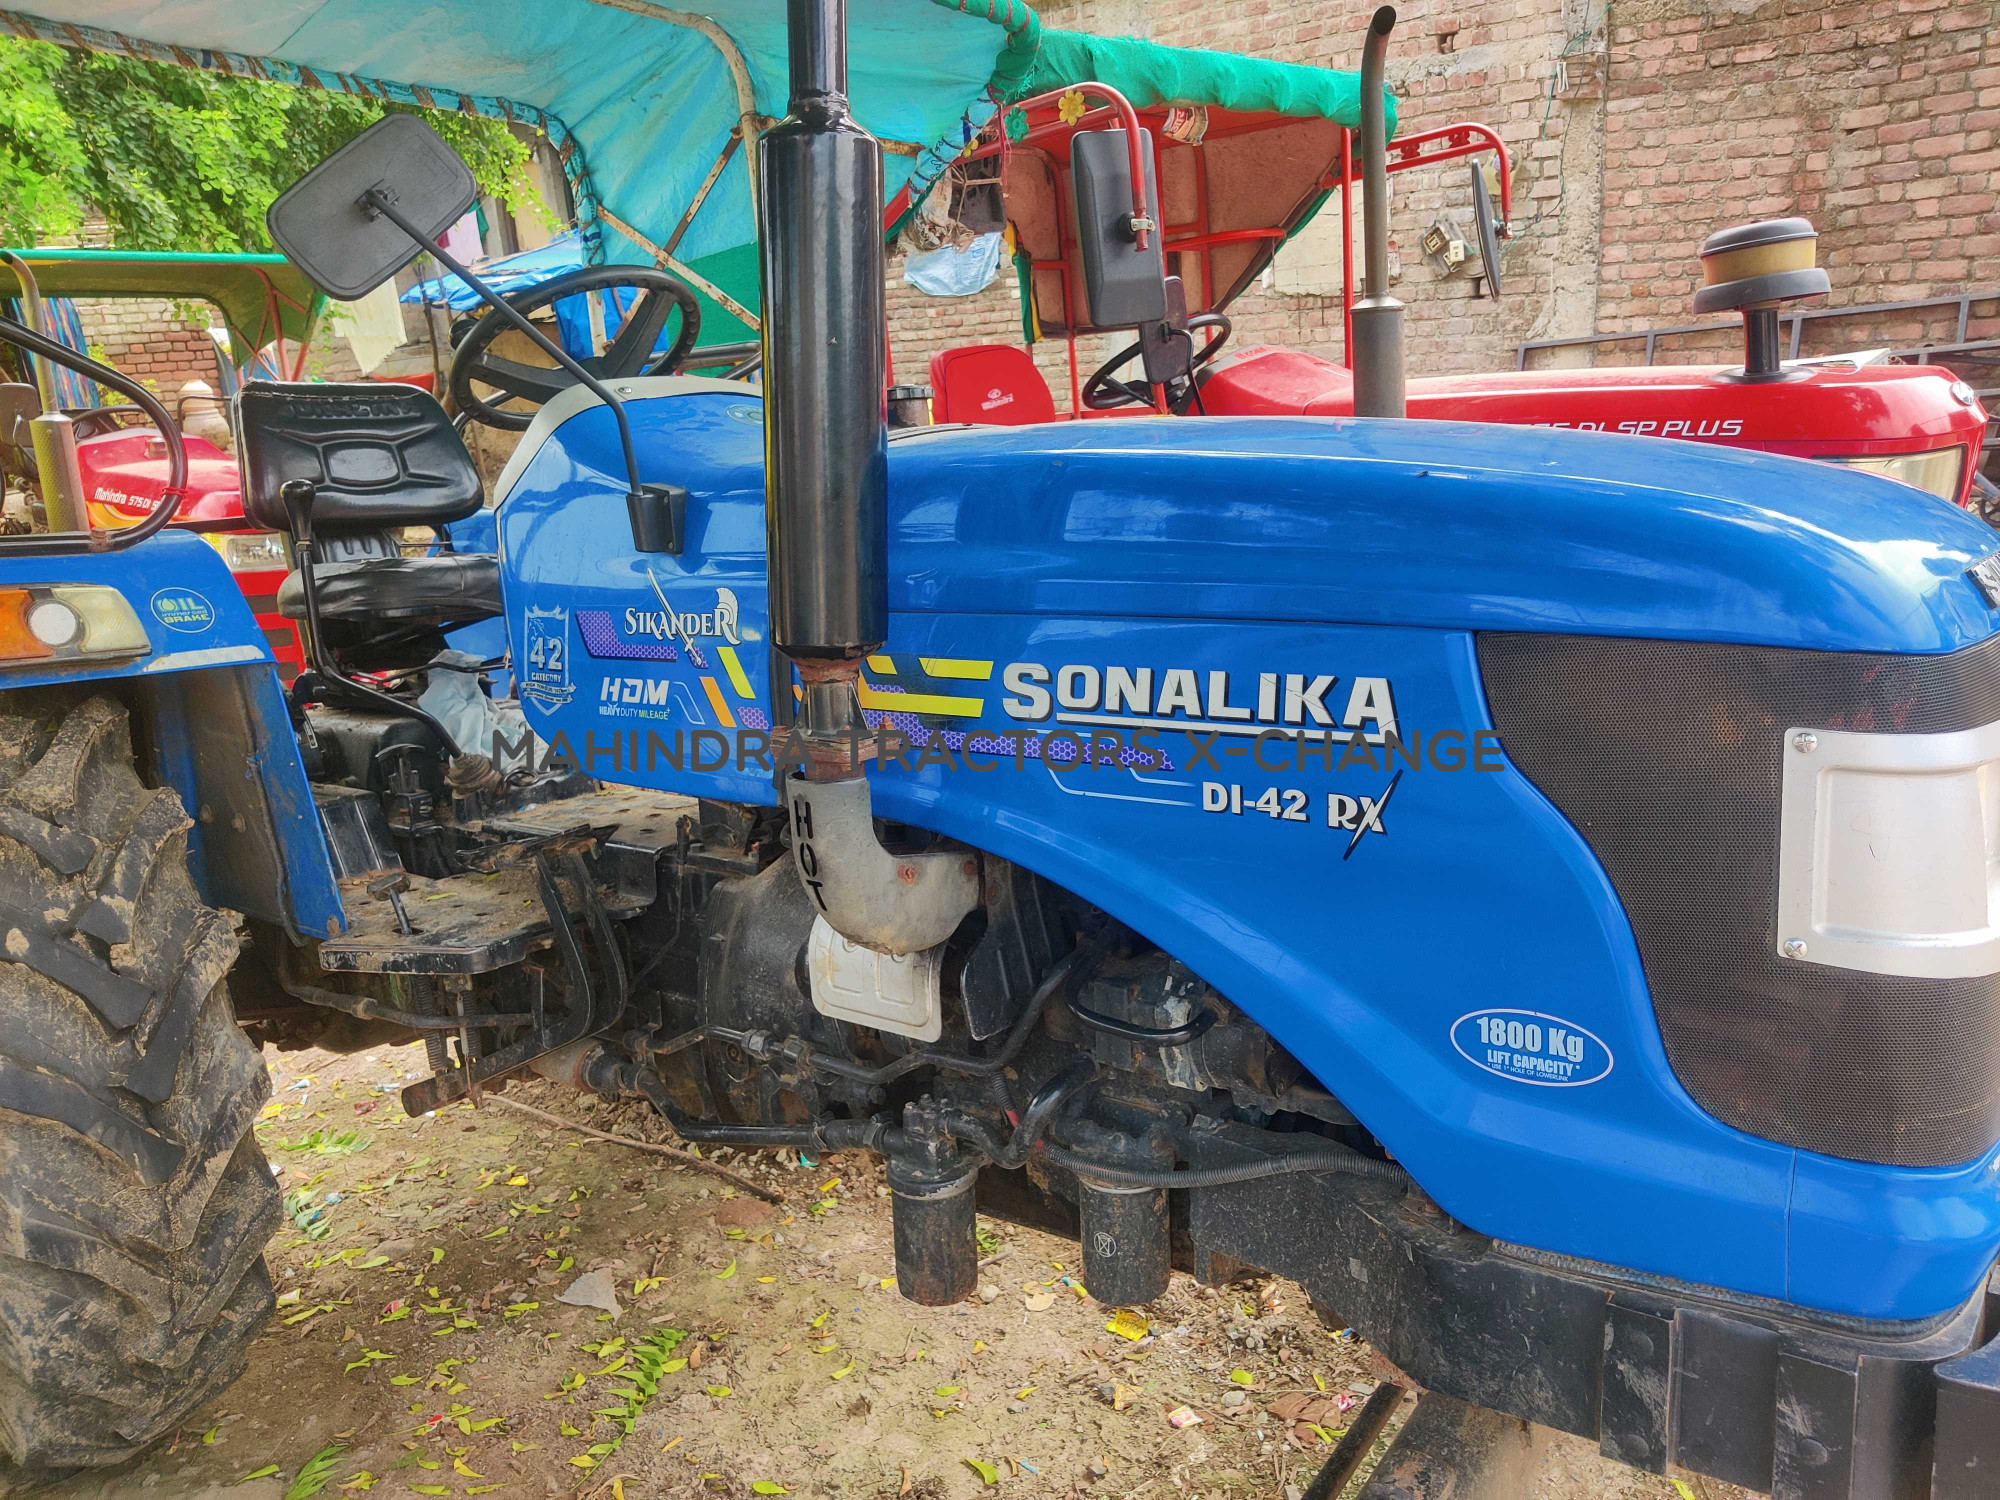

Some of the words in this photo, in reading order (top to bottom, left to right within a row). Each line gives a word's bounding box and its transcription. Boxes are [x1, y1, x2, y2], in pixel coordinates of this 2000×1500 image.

[1618, 421, 1658, 436] SP
[1661, 420, 1744, 437] PLUS
[94, 487, 127, 505] Mahindra
[157, 597, 206, 612] OIL
[164, 613, 211, 624] BRAKE
[530, 637, 563, 671] 42
[531, 672, 562, 683] CATEGORY
[600, 676, 670, 706] HDM
[599, 704, 620, 717] HEAVY
[620, 707, 638, 717] DUTY
[1002, 662, 1399, 745] SONALIKA
[1202, 781, 1309, 823] DI-42
[794, 799, 828, 912] HOT
[1476, 1016, 1542, 1053] 1800
[1548, 1027, 1584, 1063] Kg
[1487, 1049, 1511, 1065] LIFT
[1510, 1066, 1526, 1075] HOLE
